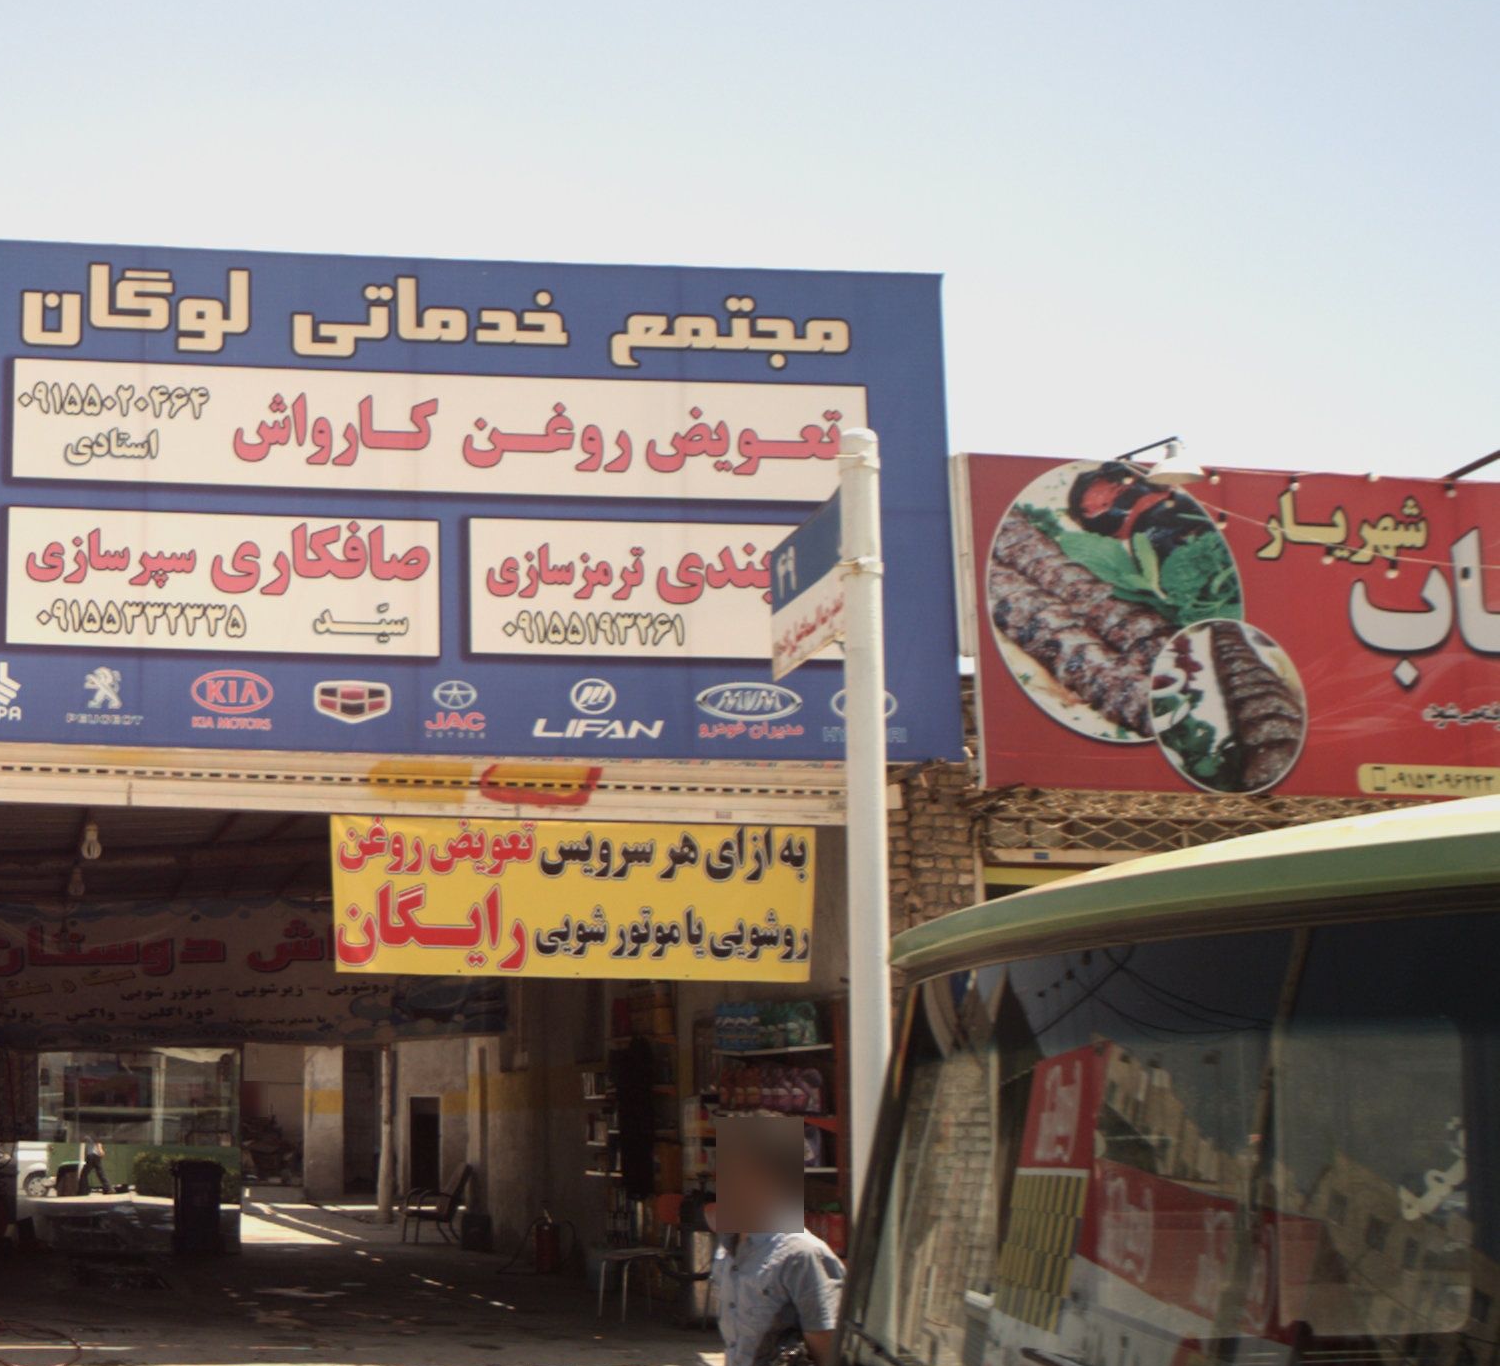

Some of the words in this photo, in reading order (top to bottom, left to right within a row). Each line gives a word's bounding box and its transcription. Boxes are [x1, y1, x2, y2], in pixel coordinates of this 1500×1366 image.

[21, 262, 251, 353] لوگان
[291, 273, 570, 358] خدماتی
[609, 295, 851, 370] مجتمع
[18, 381, 211, 419] ۰۹۱۵۵۰۲۰۴۶۴
[63, 427, 159, 465] استادی
[233, 392, 439, 466] کارواش
[462, 402, 633, 472] روغن
[646, 408, 843, 475] تعویض
[1256, 488, 1429, 563] شهریار
[211, 520, 430, 595] صافکاری
[656, 540, 773, 605] بندی
[1350, 527, 1500, 691] اب
[206, 680, 261, 703] KIA
[716, 690, 782, 711] MVM
[66, 712, 144, 726] PEUGEOT
[191, 716, 214, 729] KIA
[217, 717, 272, 731] MOTORS
[425, 711, 486, 731] JAC
[532, 718, 664, 739] LIFAN
[698, 721, 747, 739] خودرو
[749, 721, 804, 739] مدیران
[337, 815, 424, 875] روغن
[427, 818, 536, 876] تعویض
[538, 832, 655, 879] سرویس
[660, 833, 699, 879] هر
[704, 826, 774, 883] ازای
[779, 835, 809, 882] به
[335, 881, 529, 972] رایگان
[612, 906, 681, 960] موتور
[682, 907, 707, 959] یا
[708, 909, 811, 962] روشویی
